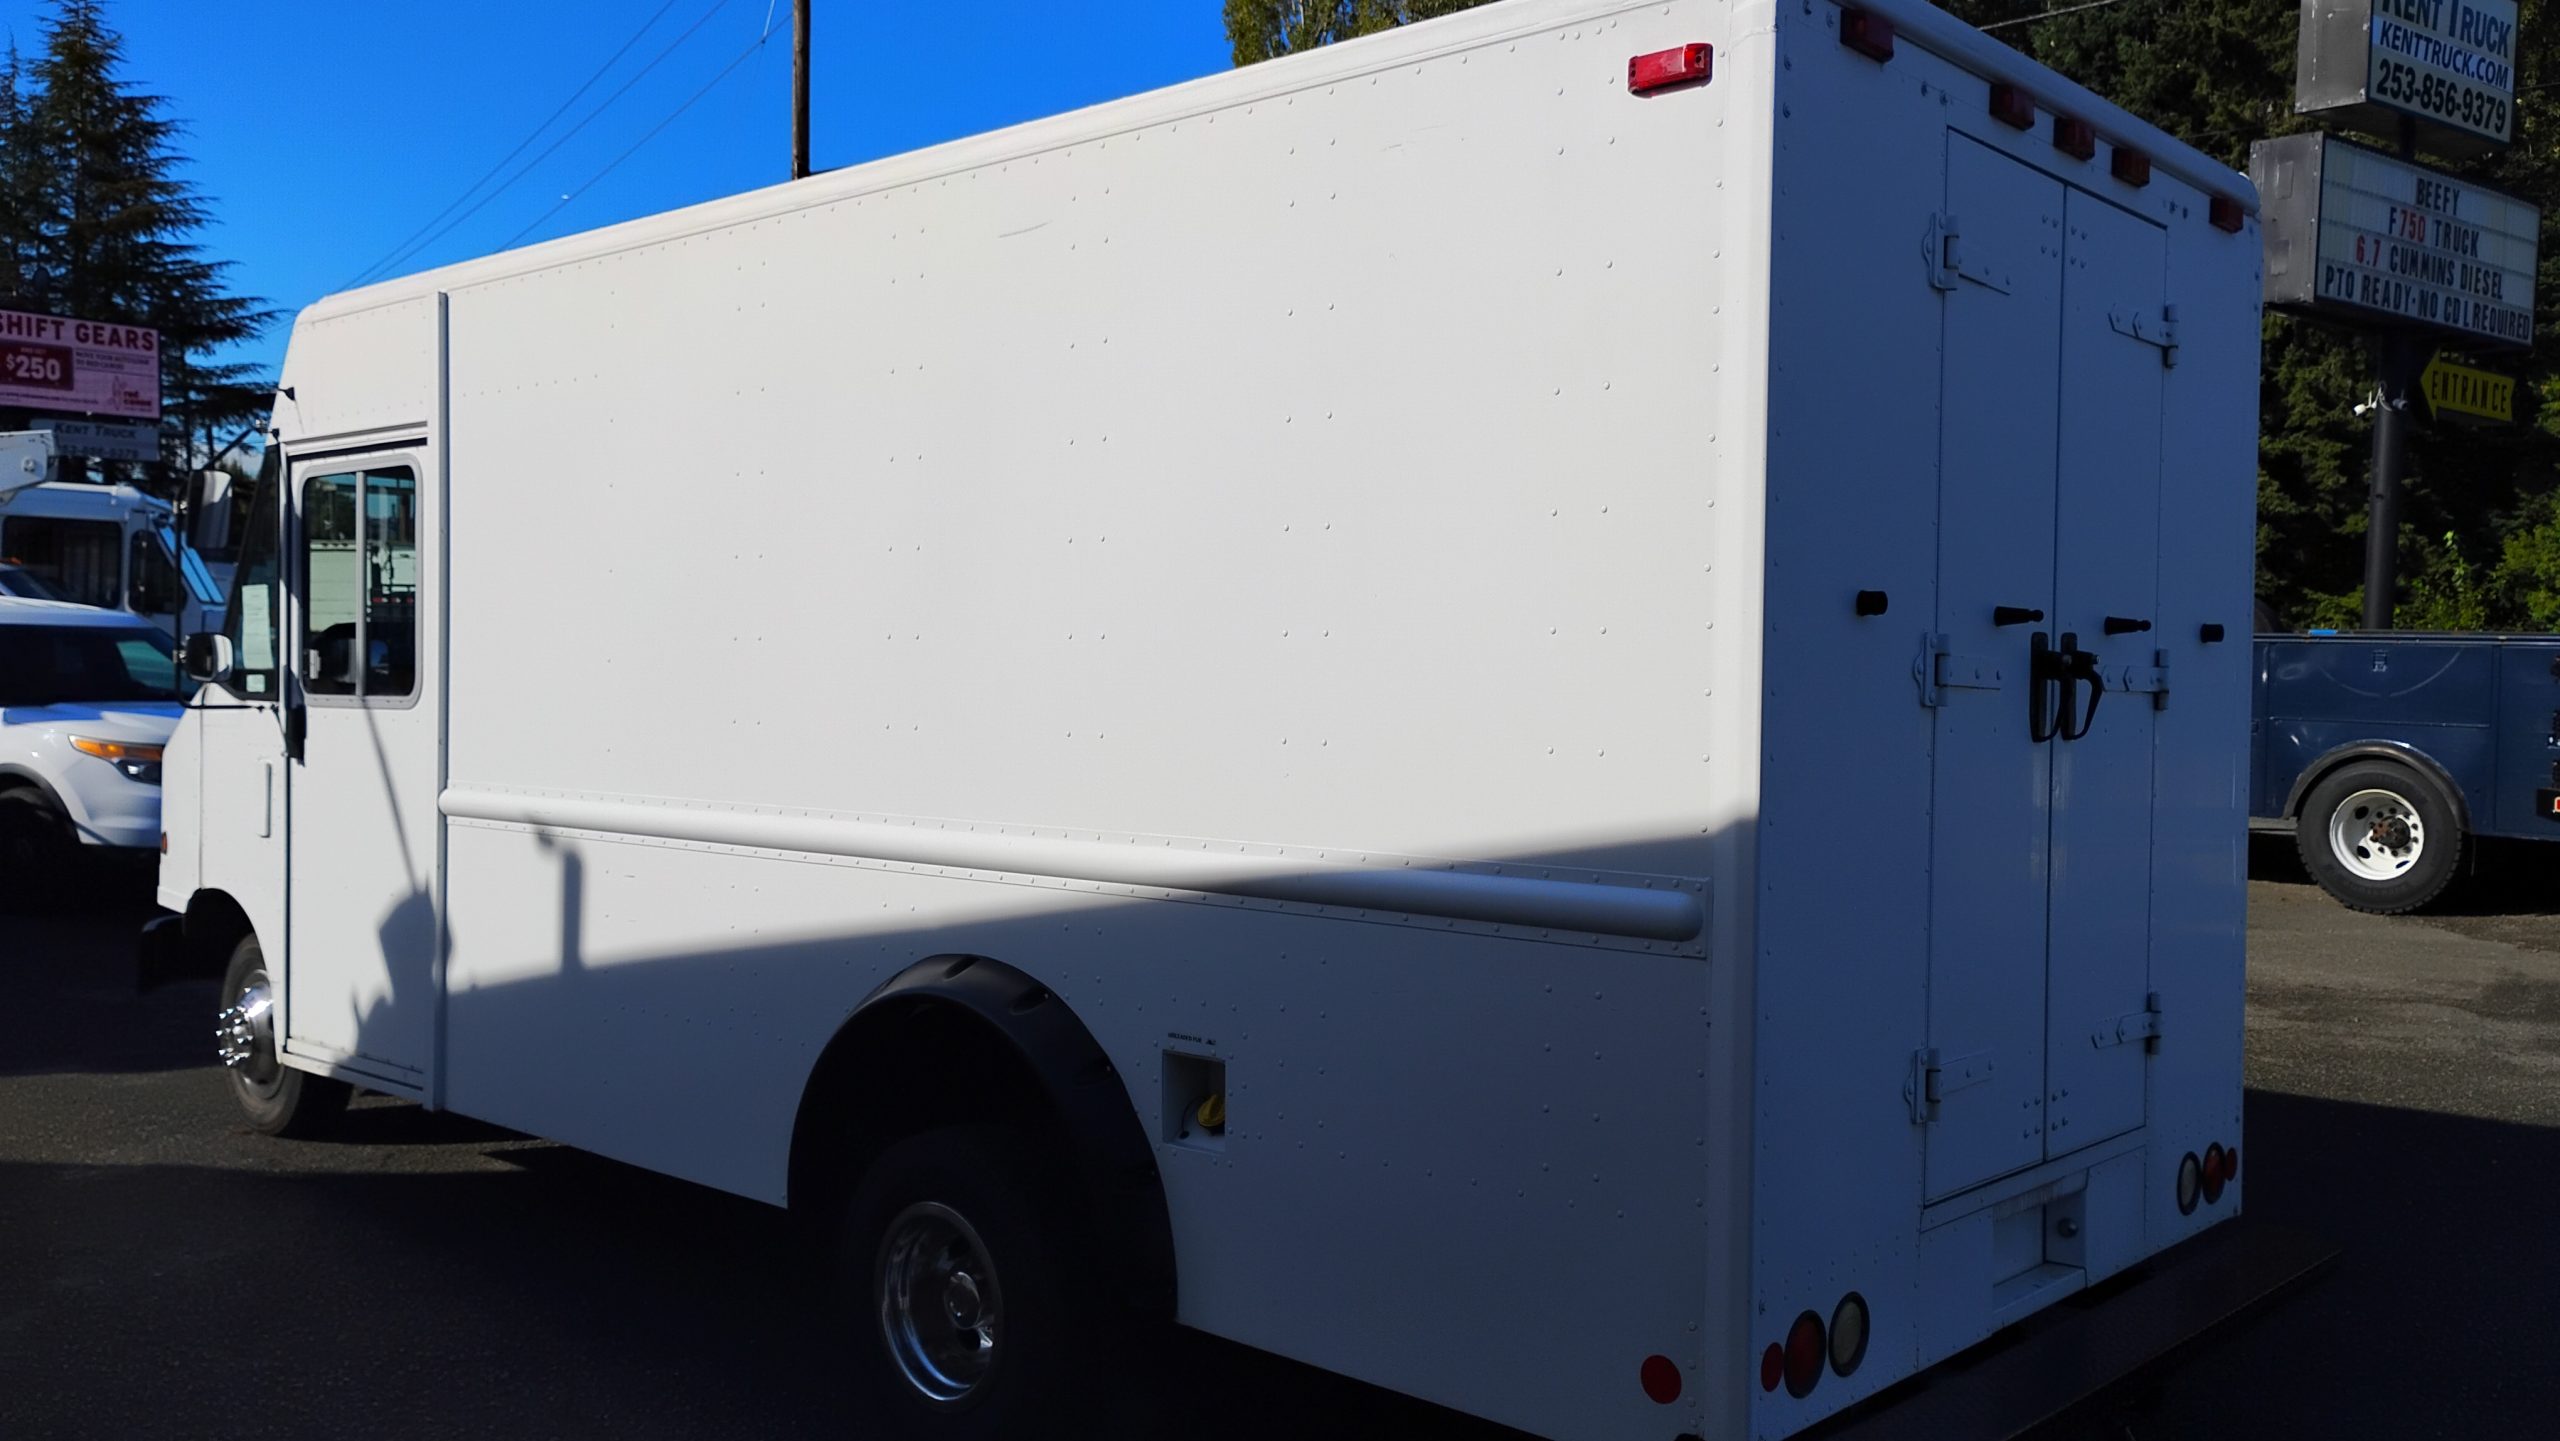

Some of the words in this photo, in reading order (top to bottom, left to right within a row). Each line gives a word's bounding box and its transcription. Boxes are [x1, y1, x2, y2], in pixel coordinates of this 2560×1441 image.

[2379, 20, 2509, 90] KENTTRUCK.COM
[2375, 58, 2507, 134] 253-856-9379
[2416, 178, 2461, 216] BEEFY
[2433, 220, 2480, 258] TRUCK
[2355, 235, 2382, 268] 6.7
[2389, 245, 2456, 288] CUMMINS
[2460, 270, 2503, 301] DIESEL
[2325, 266, 2355, 299] PTO
[2443, 296, 2470, 328] CDL
[0, 314, 65, 341] HIFT
[75, 323, 154, 352] GEARS
[6, 353, 61, 381] $250
[2431, 370, 2507, 413] ENTRANCE
